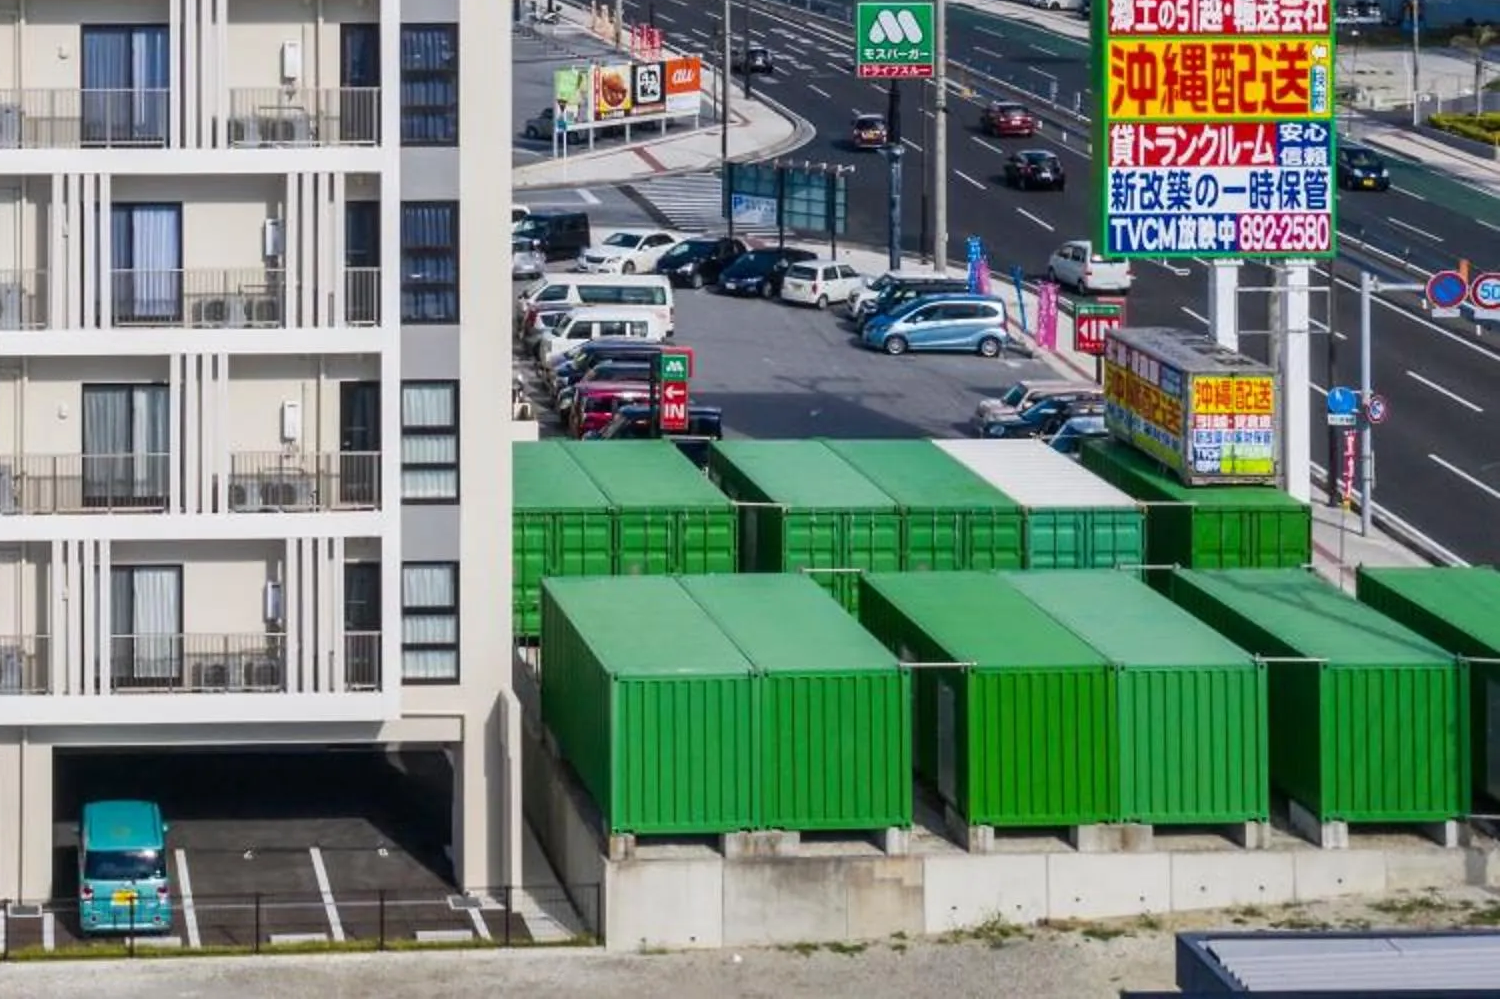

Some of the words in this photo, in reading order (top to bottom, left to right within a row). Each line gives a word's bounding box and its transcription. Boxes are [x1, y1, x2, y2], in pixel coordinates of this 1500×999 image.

[863, 48, 929, 60] モスバーガー
[1111, 43, 1308, 115] 沖縄配送
[1111, 124, 1274, 166] 貸トランクルーム
[1279, 123, 1328, 143] 安心
[1279, 147, 1328, 167] 信頼
[1111, 170, 1329, 211] 新改築の一時保管
[1239, 215, 1330, 250] 892-2580
[1481, 283, 1500, 300] 50
[1194, 380, 1271, 410] 沖縄配送
[664, 403, 685, 419] IN
